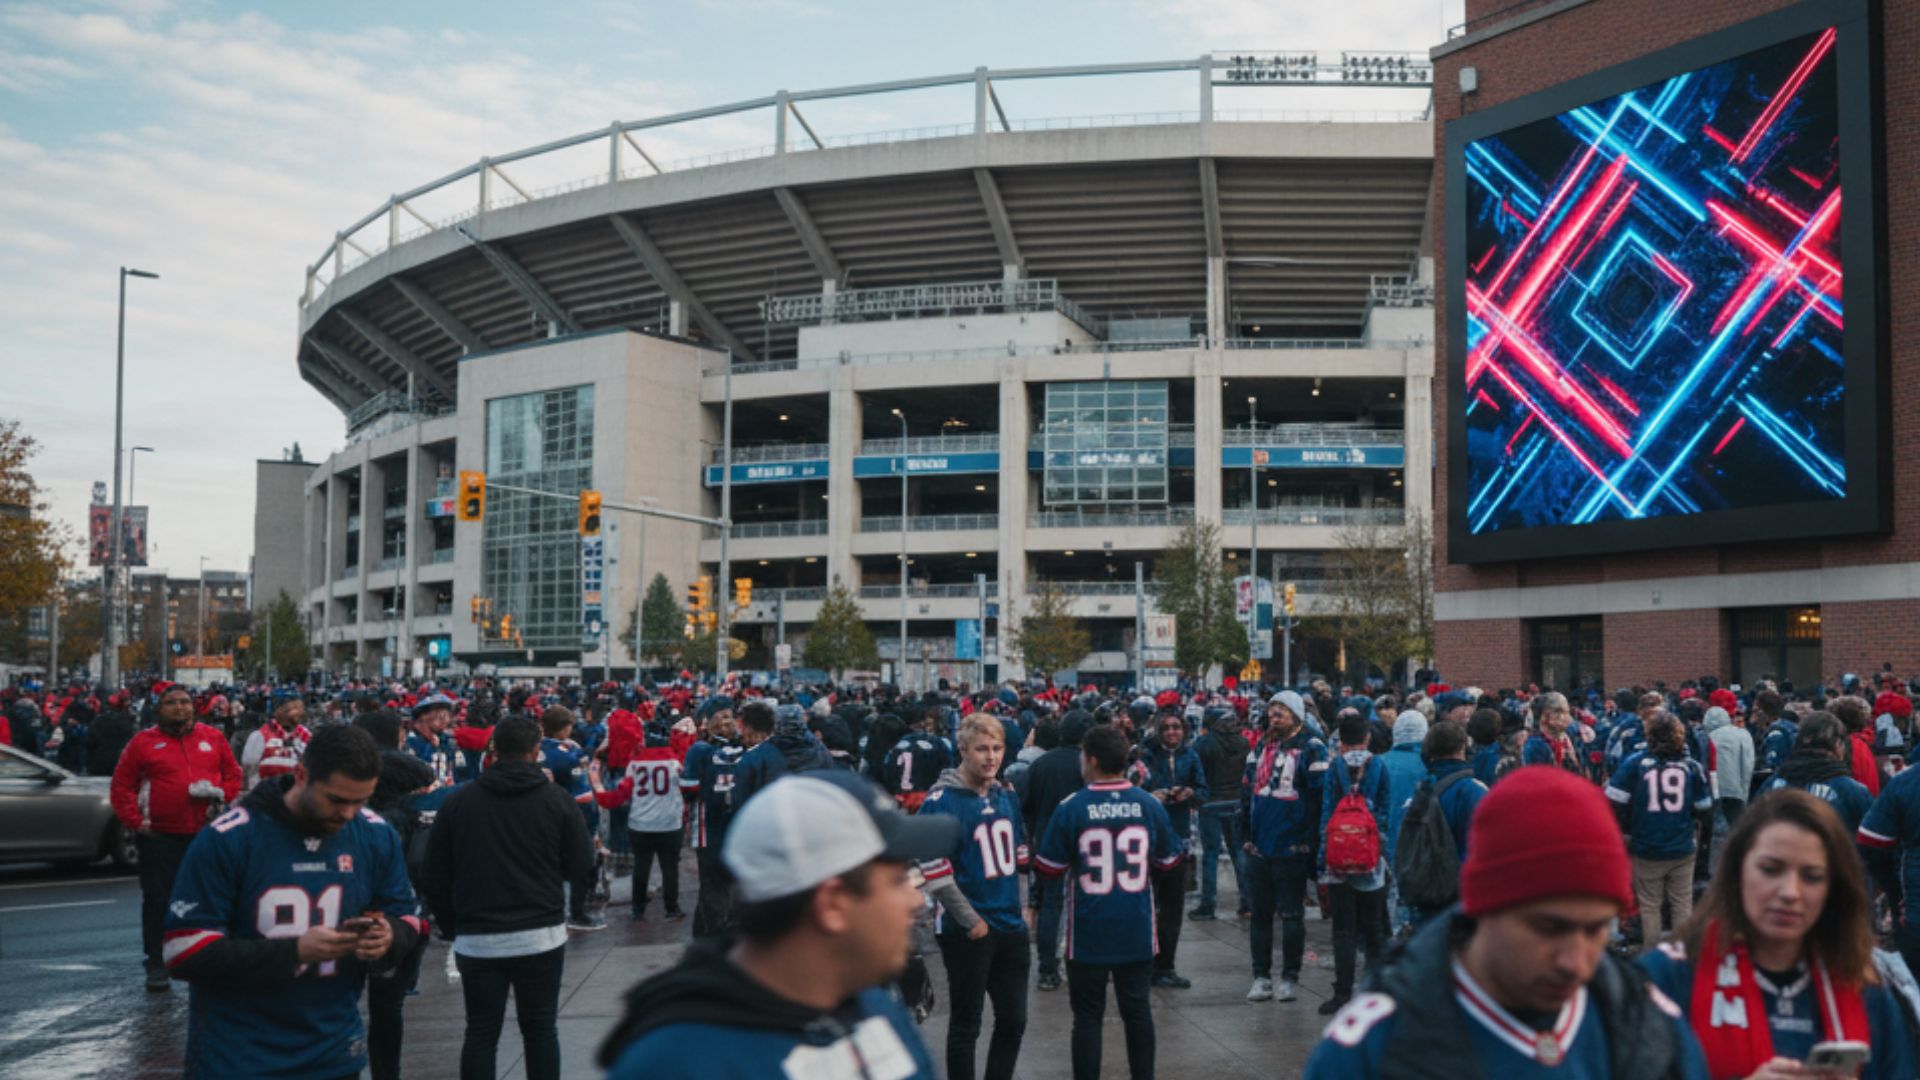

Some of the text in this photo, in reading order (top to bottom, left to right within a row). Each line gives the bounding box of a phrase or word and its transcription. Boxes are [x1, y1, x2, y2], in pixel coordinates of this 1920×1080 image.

[637, 766, 669, 796] 20
[1644, 770, 1687, 812] 19
[973, 818, 1017, 880] 10
